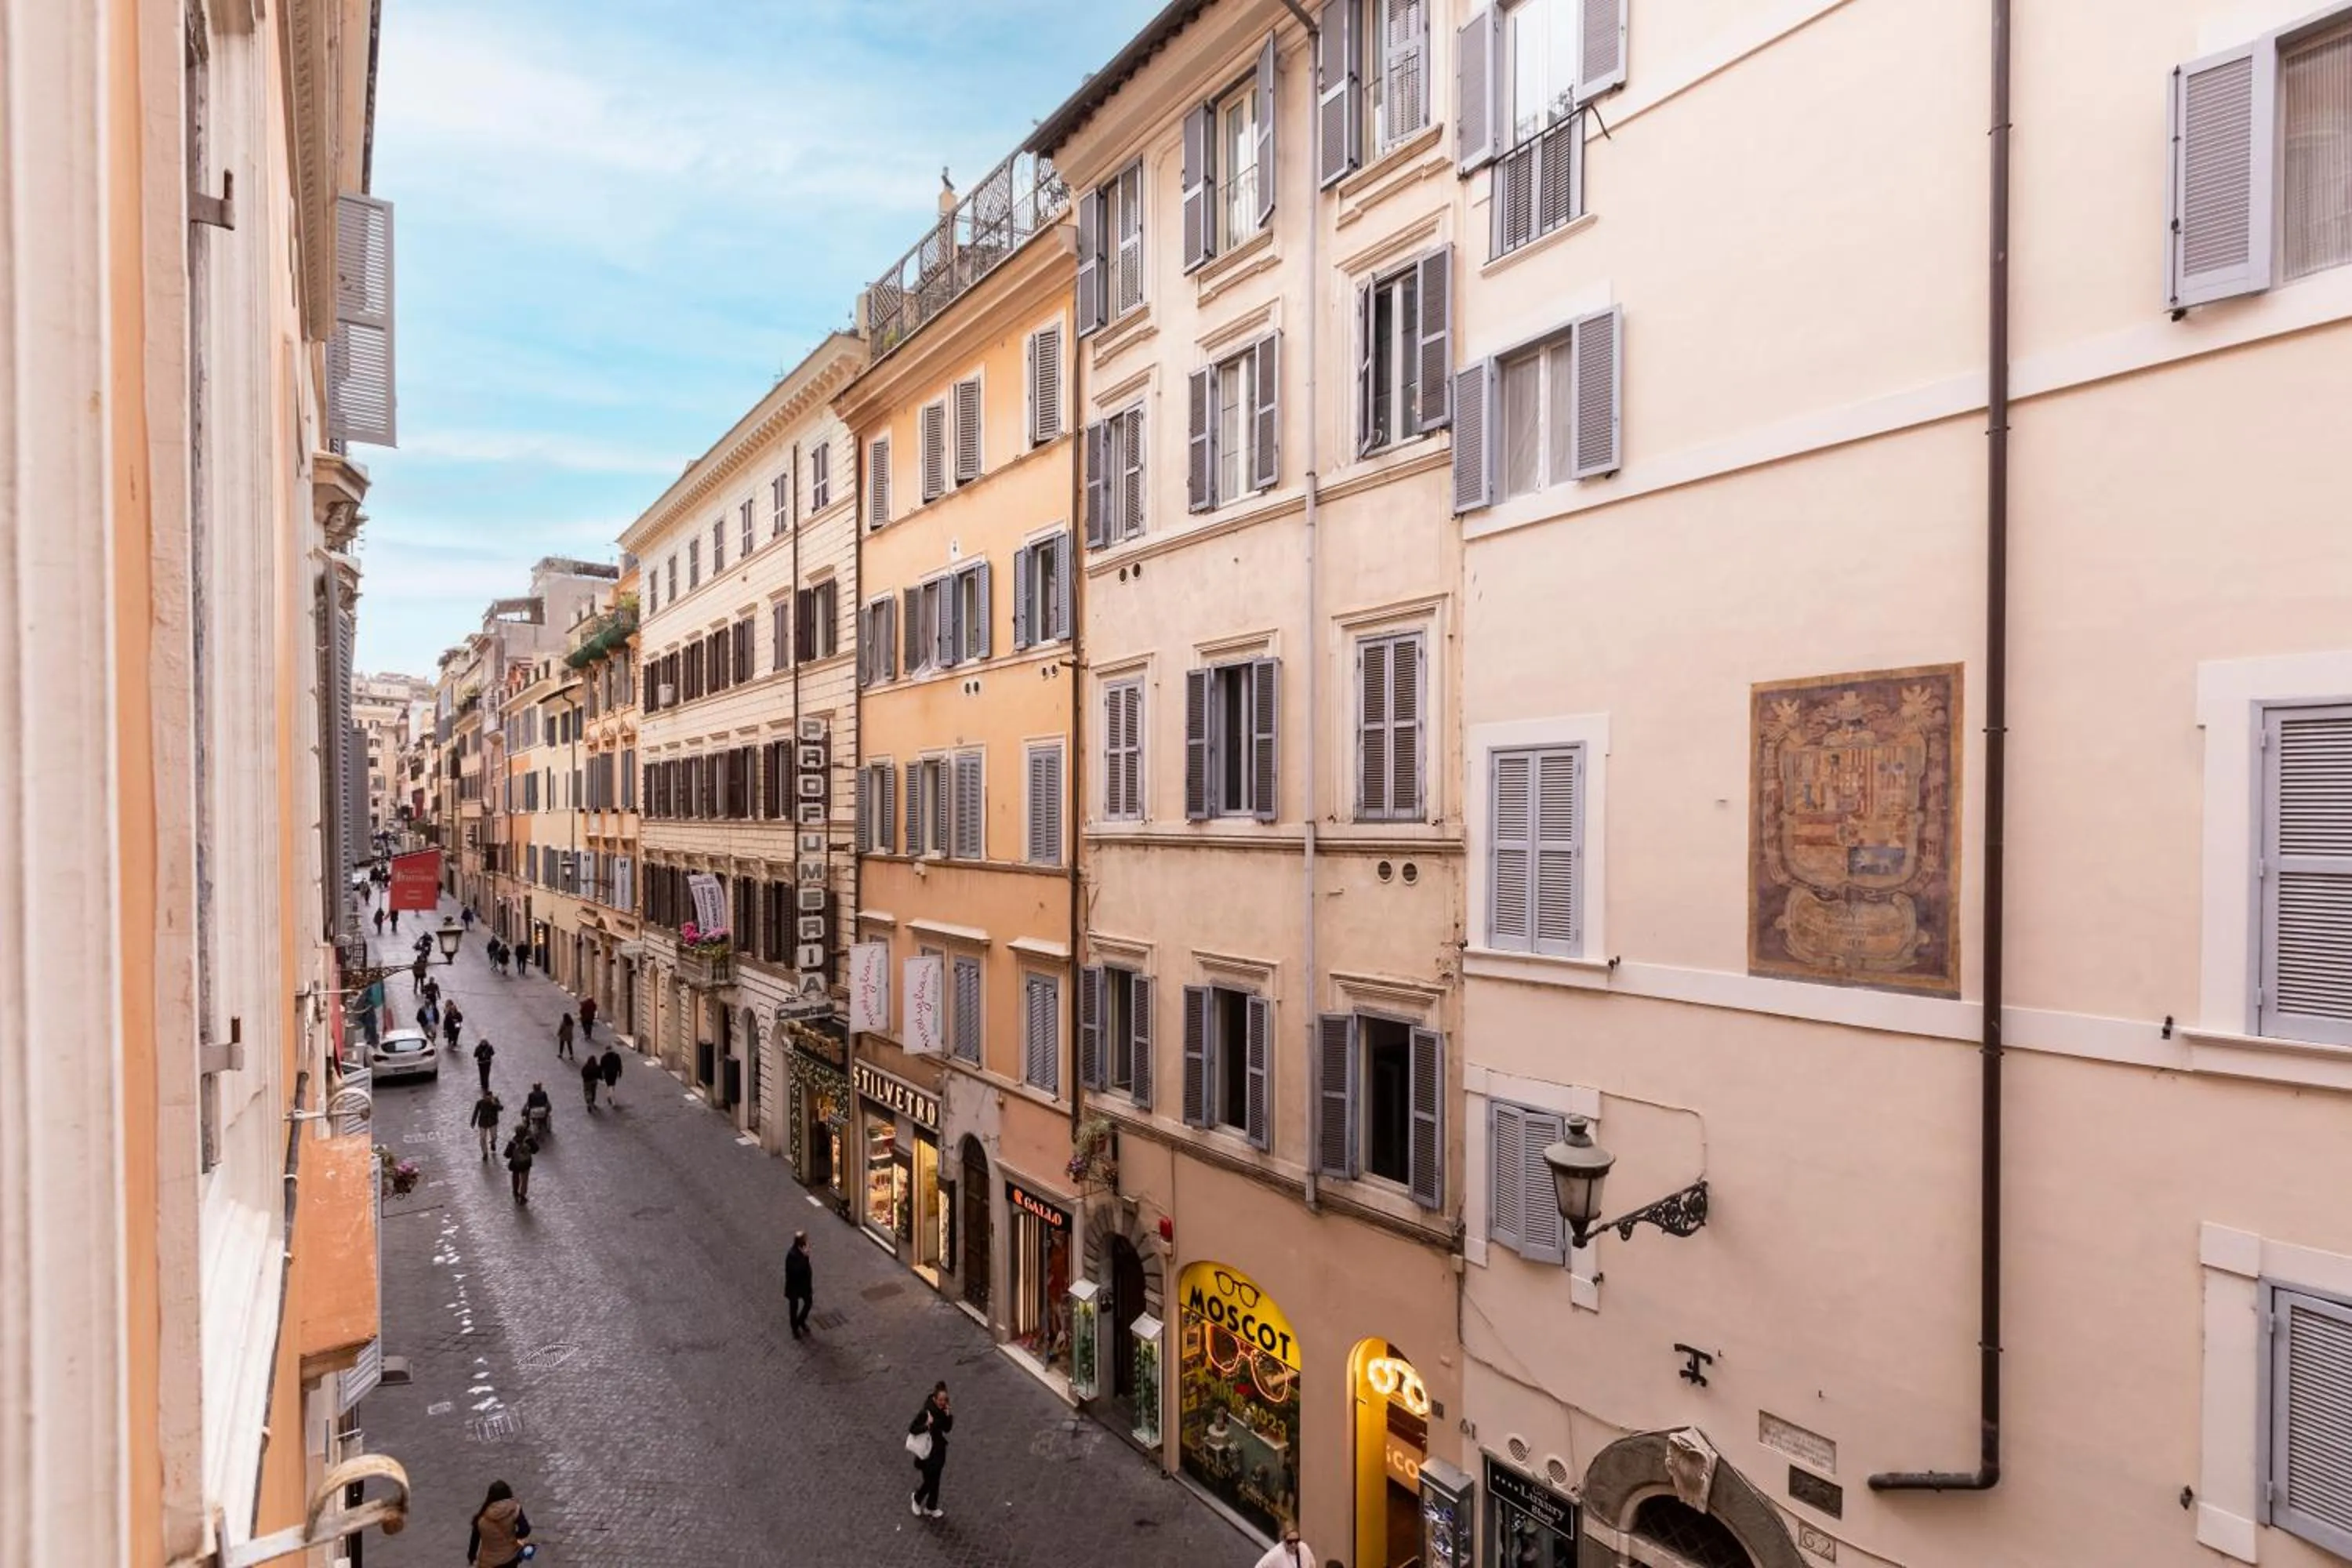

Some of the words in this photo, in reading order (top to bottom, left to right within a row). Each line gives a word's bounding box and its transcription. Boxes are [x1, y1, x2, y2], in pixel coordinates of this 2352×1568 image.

[801, 720, 823, 993] PROFUMERIA
[852, 1066, 935, 1127] STILVETRO
[1024, 1196, 1062, 1227] GALLO
[1189, 1285, 1291, 1360] MOSCOT
[1520, 1483, 1565, 1521] Luxury
[1803, 1530, 1831, 1559] 62
